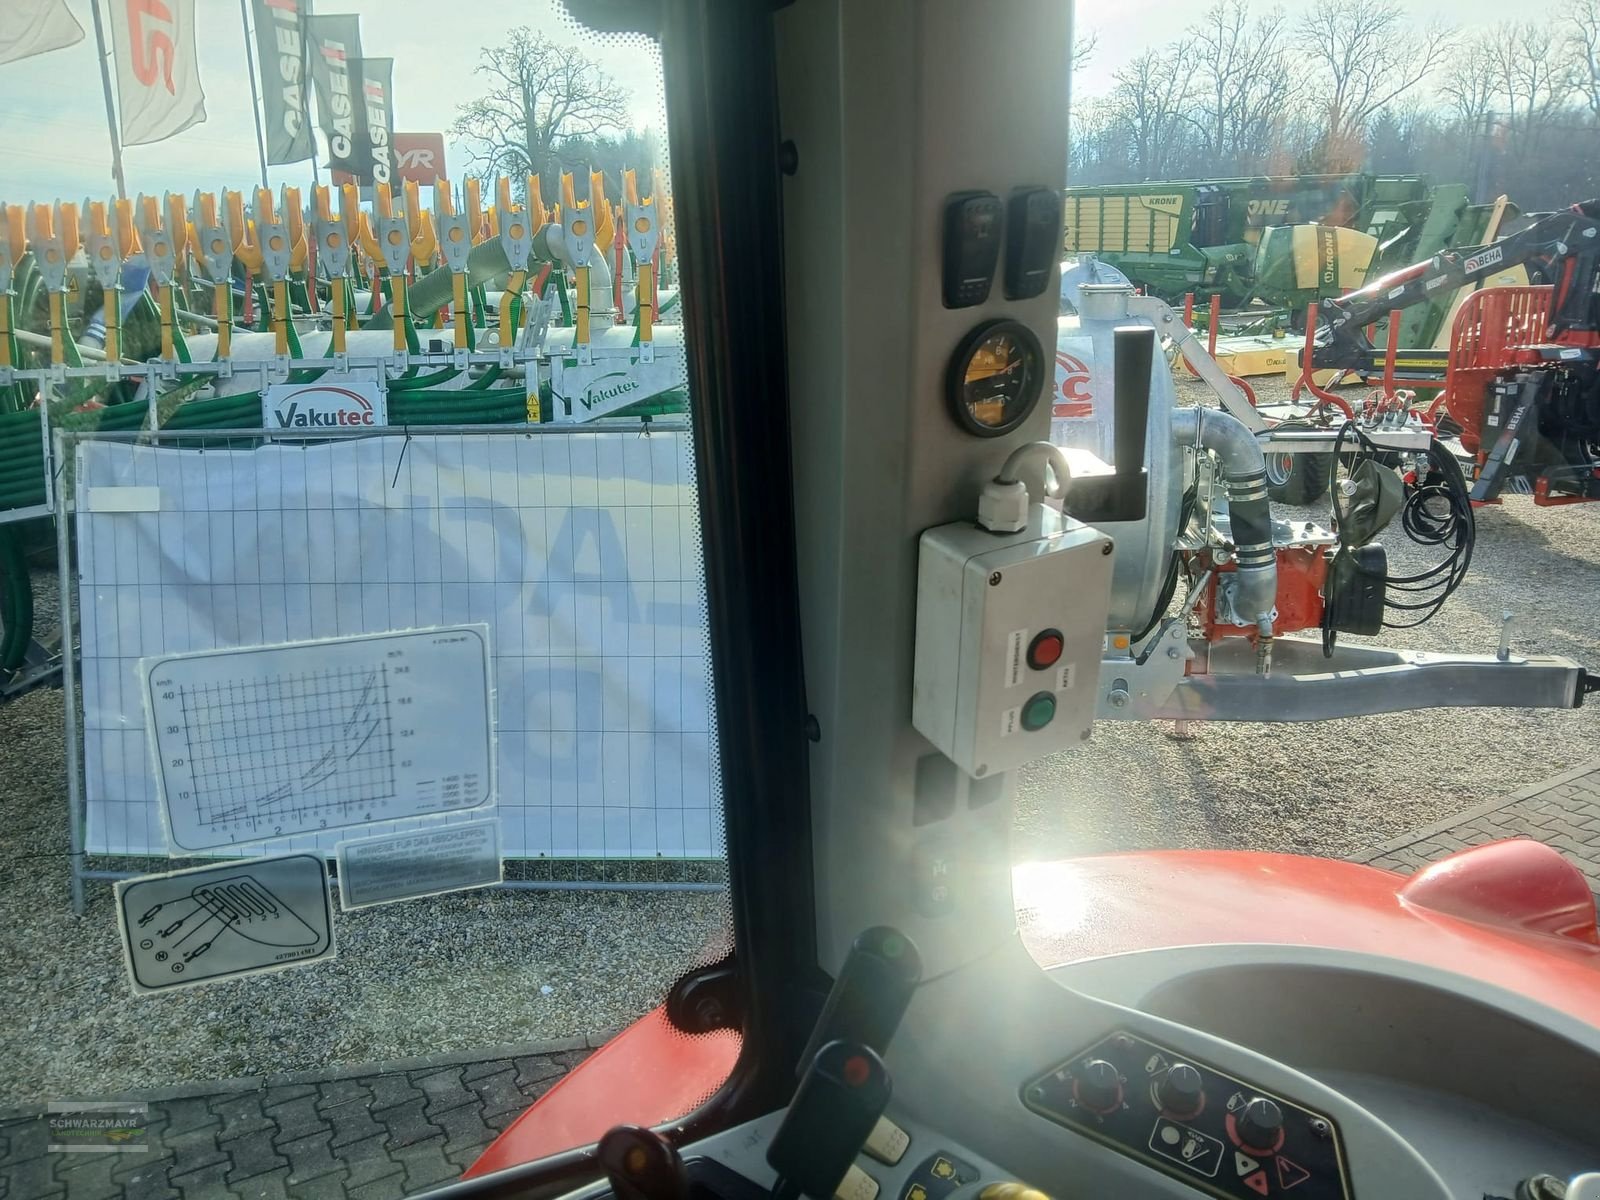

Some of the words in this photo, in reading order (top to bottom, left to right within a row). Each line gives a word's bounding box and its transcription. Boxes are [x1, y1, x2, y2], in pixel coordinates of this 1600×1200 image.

[275, 25, 302, 139] CASE
[329, 71, 352, 159] CASE
[366, 106, 391, 184] CASE
[1149, 197, 1178, 206] KRONE
[1325, 232, 1335, 271] KRONE
[1479, 249, 1501, 266] BEHA
[579, 381, 640, 411] Vakutec
[274, 402, 375, 428] Vakutec
[1507, 405, 1526, 430] BEHA
[162, 691, 175, 700] 40
[167, 726, 179, 734] 30
[172, 759, 184, 767] 20
[178, 791, 189, 800] 10
[230, 834, 235, 843] 1
[274, 826, 282, 836] 2
[320, 819, 327, 828] 3
[364, 812, 371, 821] 4
